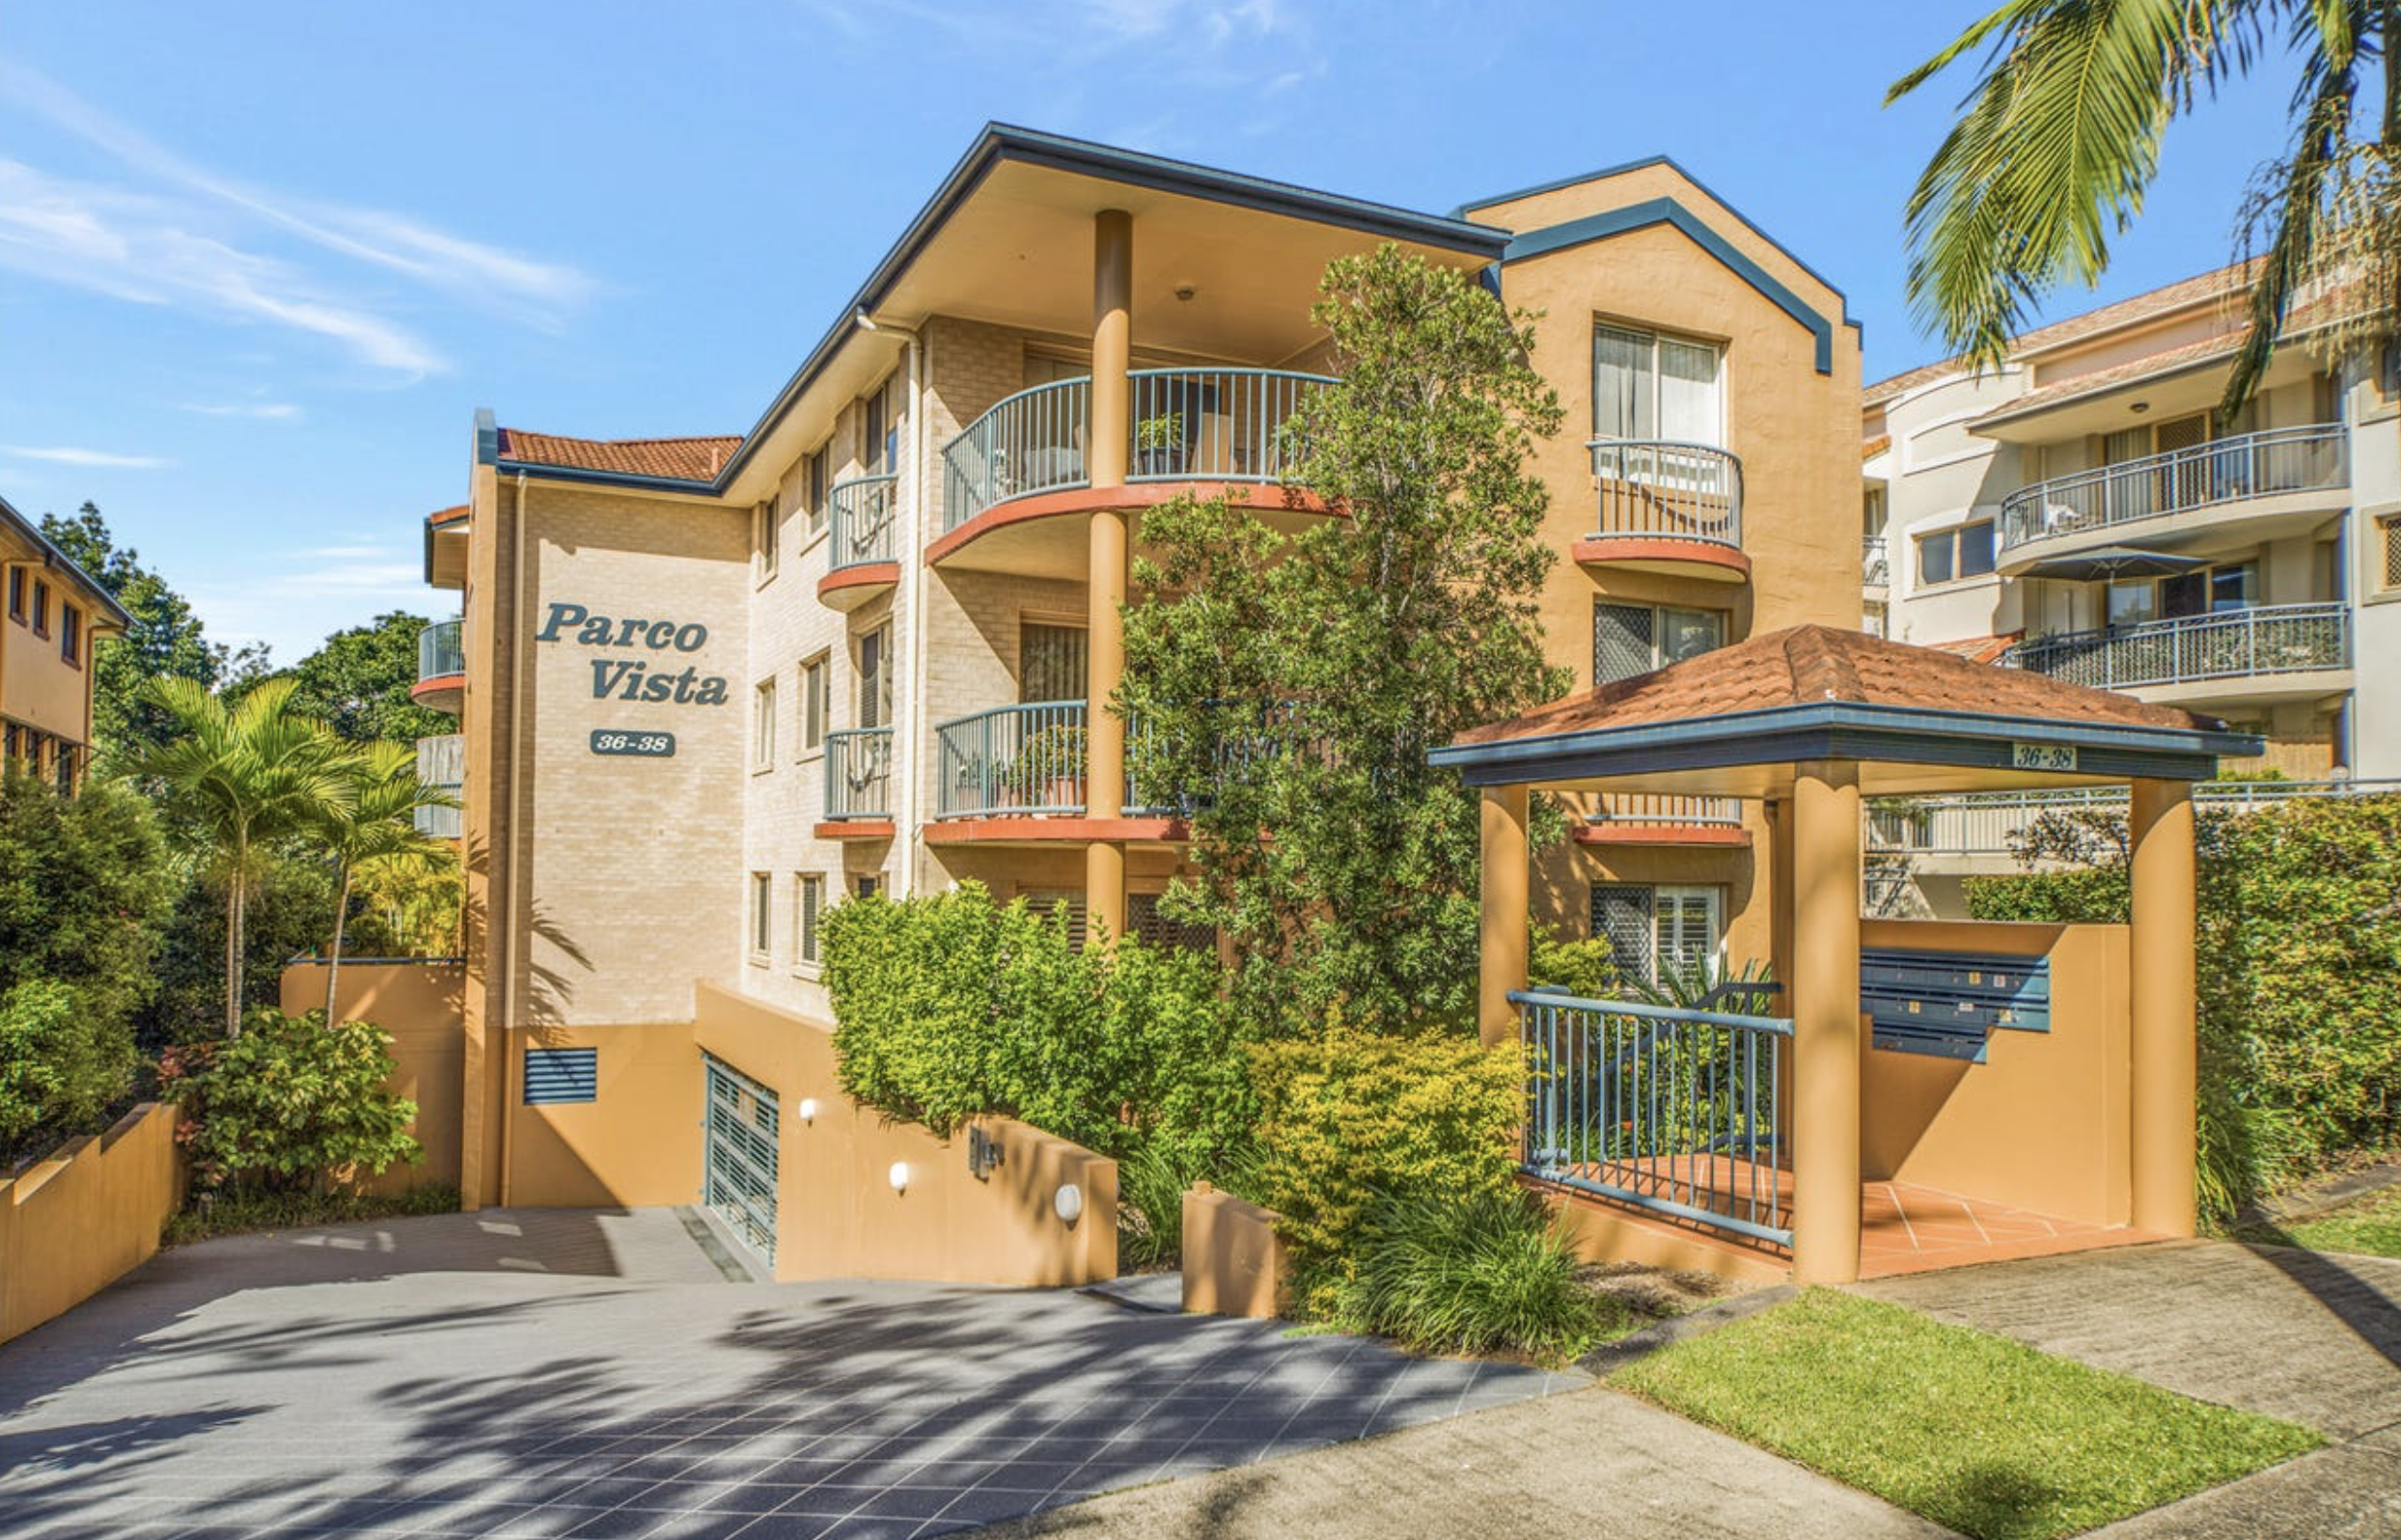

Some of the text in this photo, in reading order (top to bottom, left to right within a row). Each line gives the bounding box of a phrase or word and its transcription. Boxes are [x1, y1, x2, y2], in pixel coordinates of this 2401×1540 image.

[536, 602, 707, 652] Parco
[591, 659, 729, 705] Vista
[596, 734, 667, 752] 36-38
[2018, 745, 2074, 767] 36-38
